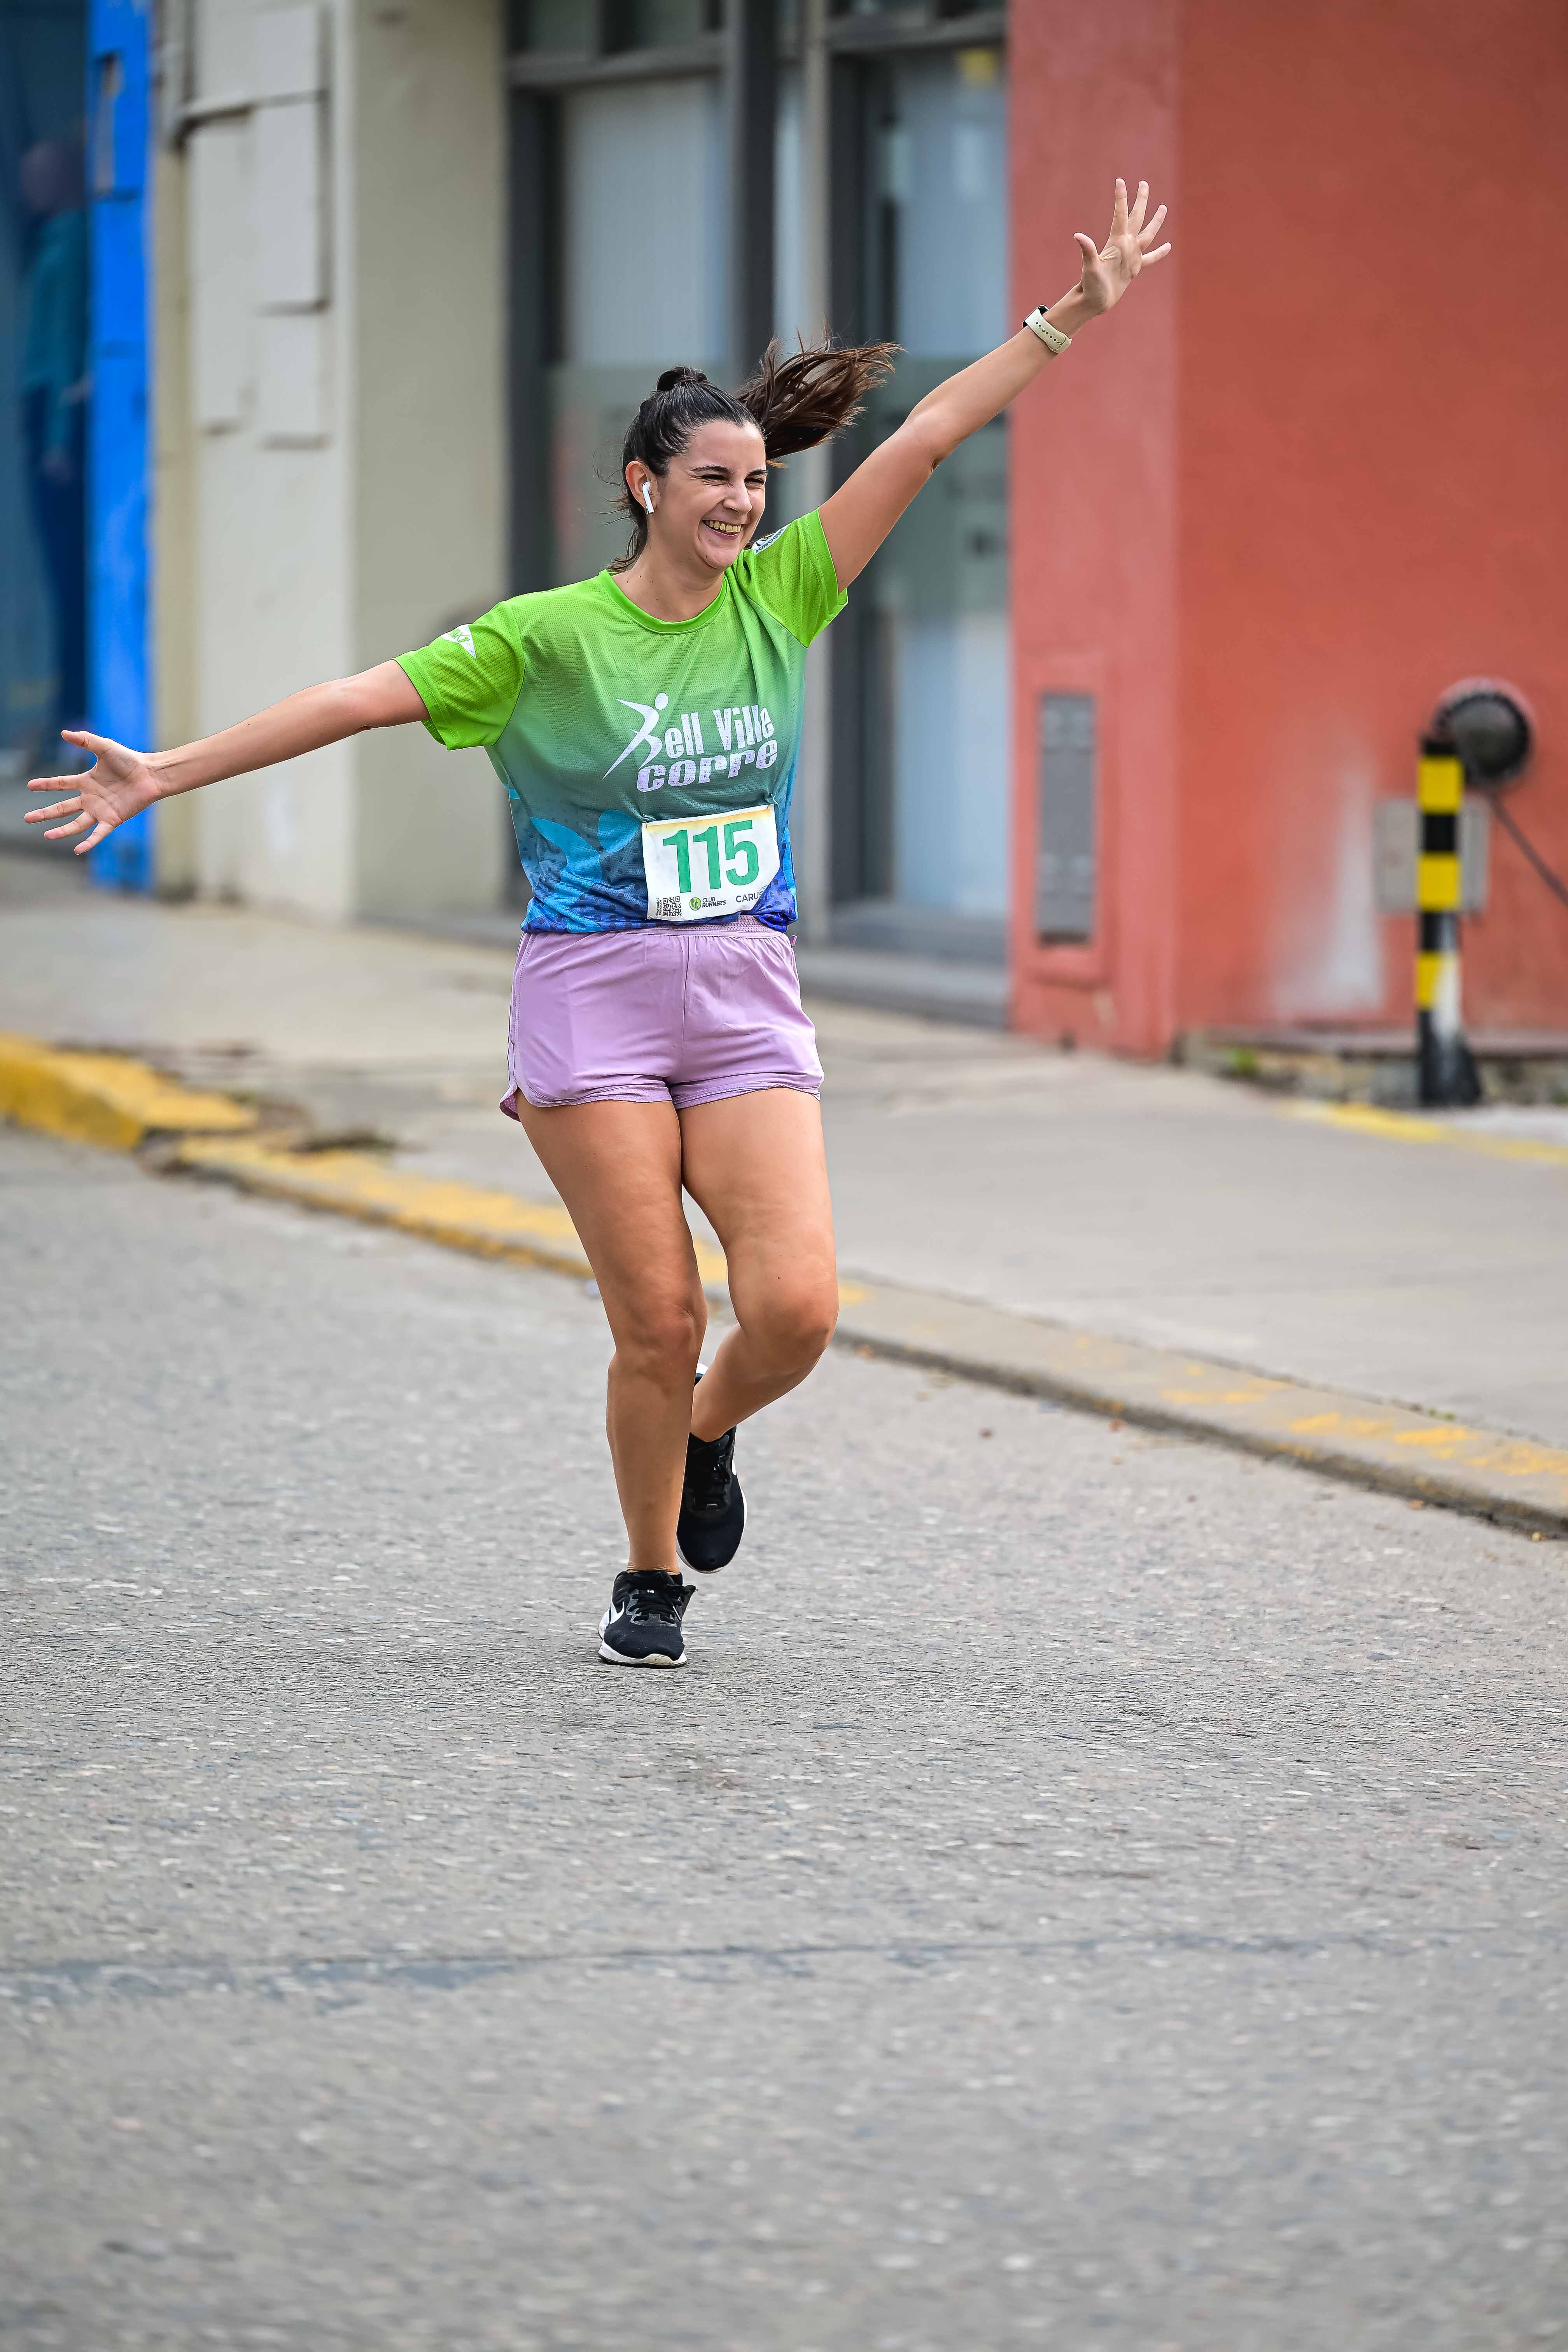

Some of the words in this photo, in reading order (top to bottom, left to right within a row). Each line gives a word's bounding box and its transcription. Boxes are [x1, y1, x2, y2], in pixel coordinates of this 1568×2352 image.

[712, 704, 775, 751] Ville
[637, 739, 777, 793] corre
[663, 819, 759, 894] 115
